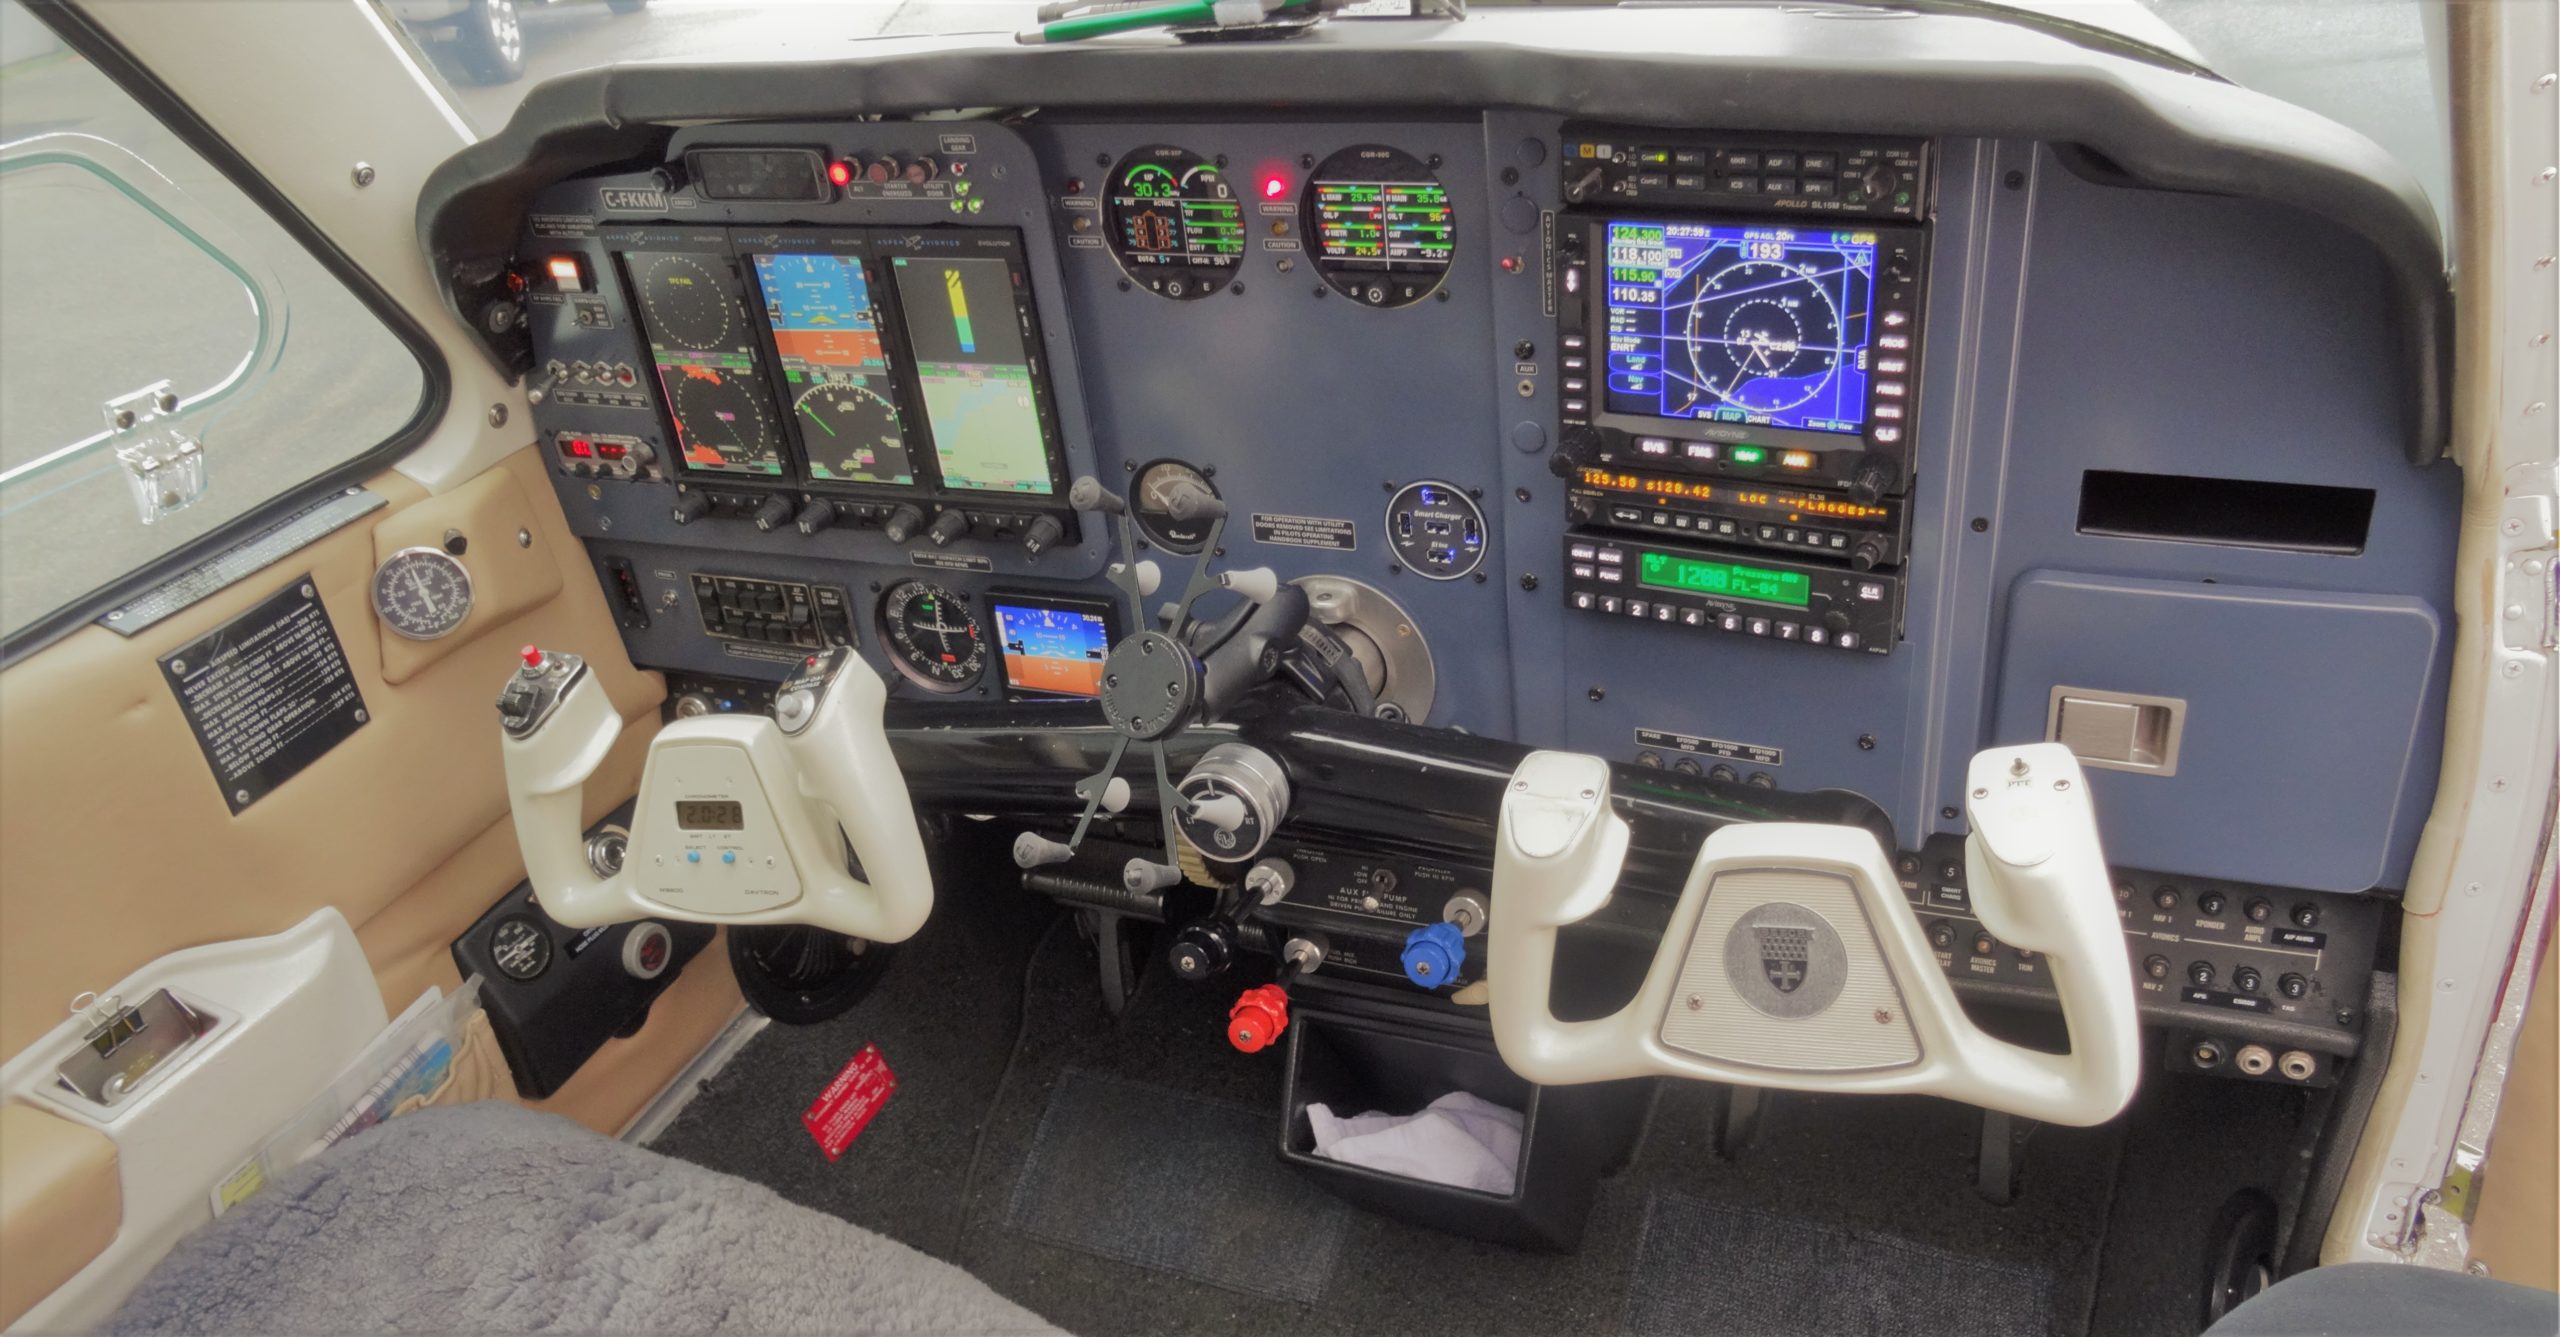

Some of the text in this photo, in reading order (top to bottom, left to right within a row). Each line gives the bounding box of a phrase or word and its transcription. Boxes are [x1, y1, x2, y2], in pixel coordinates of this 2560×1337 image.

[1583, 146, 1591, 154] M
[1768, 159, 1782, 167] ADF
[1805, 160, 1823, 168] DME
[1731, 181, 1743, 189] ICS
[1767, 183, 1782, 191] AUX
[605, 191, 665, 209] C-FKKM
[1774, 200, 1807, 208] APOLLO
[1612, 227, 1662, 241] 124.300
[1744, 232, 1775, 240] GPS AGL
[1851, 233, 1877, 245] GPS
[920, 239, 960, 247] AVIONICS
[1612, 247, 1663, 261] 118.100
[1750, 242, 1782, 259] 193
[1612, 268, 1656, 283] 115.90
[1203, 283, 1210, 292] E
[1612, 287, 1656, 303] 110.35
[1611, 344, 1635, 352] ENRT
[1723, 412, 1742, 421] MAP
[1748, 415, 1771, 424] CHART
[1642, 441, 1665, 454] SVS
[1739, 493, 1768, 504] LOC
[1414, 510, 1462, 520] Smart Charger
[1255, 521, 1275, 529] DOORS
[1276, 523, 1304, 531] REMOVED
[1315, 526, 1352, 535] LIMITATIONS
[1273, 517, 1307, 525] OPERATION
[1323, 520, 1345, 528] UTILITY
[1302, 532, 1334, 540] OPERATING
[1698, 521, 1709, 530] SYS
[1720, 524, 1731, 534] OBS
[1808, 535, 1819, 544] SEL
[1832, 538, 1843, 547] ENT
[1269, 536, 1340, 547] HANDBOOK SUPPLEMENT
[1571, 549, 1620, 562] IDENT MODE
[1575, 568, 1620, 581] VFR FUNC
[1861, 586, 1879, 595] CLR
[1579, 597, 1851, 646] 0 1 2 3 4 5 6 7 8 9
[211, 624, 275, 667] AIRSPEED LIMITATIONS
[275, 637, 294, 651] ABOVE
[890, 609, 899, 618] E
[931, 666, 940, 676] N
[951, 669, 965, 679] 33
[185, 680, 204, 695] NEVER
[207, 665, 229, 682] EXCEED
[309, 609, 319, 619] KTS
[213, 626, 327, 701] STRUCTURAL CRUISE KTS
[282, 654, 302, 669] ABOVE
[331, 659, 341, 668] KTS
[221, 642, 334, 718] MANEUVERING KTS
[225, 651, 338, 728] APPROACH KTS
[342, 683, 351, 692] KTS
[345, 692, 355, 701] KTS
[234, 668, 344, 744] FULL DOWN KTS
[238, 720, 283, 752] LANDING GEAR
[1642, 731, 1661, 739] SPARE
[1712, 742, 1738, 751] EFD1000
[1749, 748, 1777, 756] EFD1000
[1293, 853, 1327, 863] PUSH OPEN
[1414, 871, 1455, 882] PUSH RPM
[1947, 867, 1955, 877] 5
[1339, 887, 1359, 896] AUX
[1383, 893, 1407, 903] PUMP
[1941, 886, 1962, 894] SMART
[1330, 901, 1352, 910] DRIVEN
[1399, 911, 1416, 919] ONLY
[1395, 904, 1418, 913] ENGINE
[2211, 902, 2219, 910] 3
[2153, 913, 2166, 922] NAV
[2303, 913, 2311, 923] 2
[2195, 919, 2225, 930] XPONDER
[2244, 926, 2265, 935] AUDIO
[2151, 932, 2180, 943] AVIONICS
[2243, 934, 2262, 943] AMPL
[1970, 956, 1997, 967] AVIONICS
[1970, 964, 1995, 974] MASTER
[2018, 963, 2034, 972] TRIM
[2200, 972, 2208, 982] 2
[2142, 982, 2163, 992] NAV 2
[2246, 978, 2254, 988] 3
[2291, 984, 2299, 993] 3
[822, 1062, 858, 1101] WARNING
